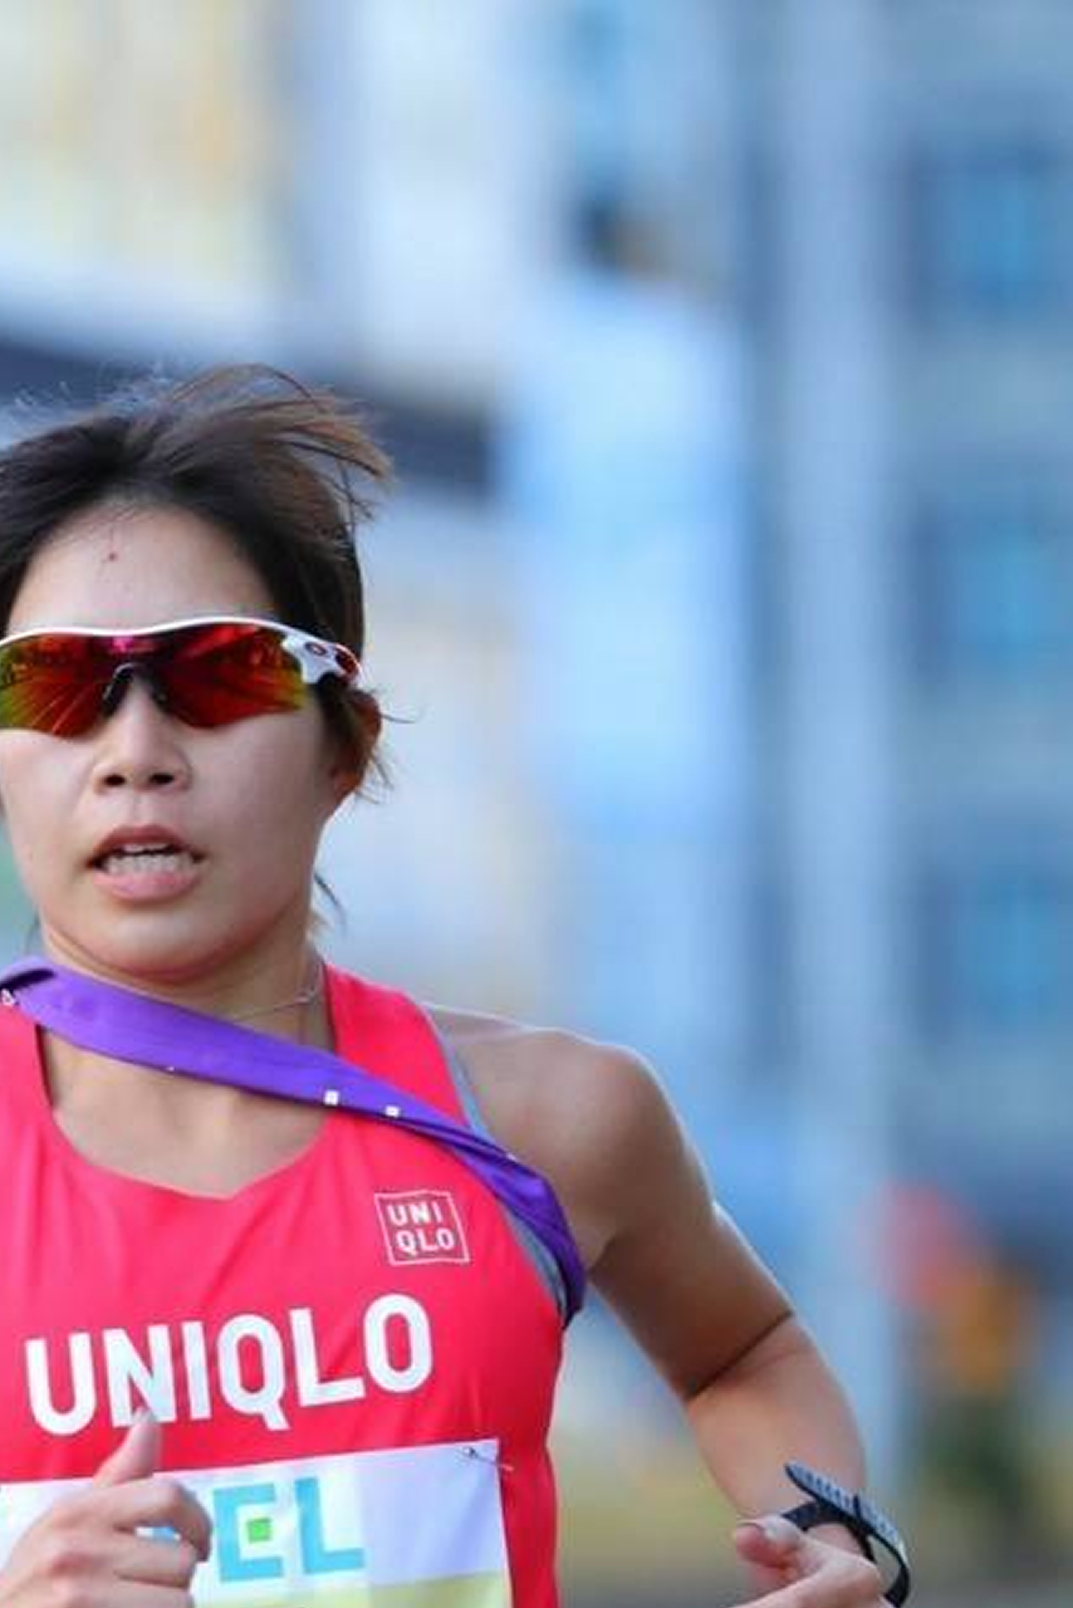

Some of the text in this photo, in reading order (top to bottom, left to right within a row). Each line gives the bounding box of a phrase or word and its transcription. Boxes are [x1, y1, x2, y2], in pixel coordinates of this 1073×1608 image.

[387, 1201, 443, 1226] UNI
[396, 1227, 455, 1256] QLO
[25, 1294, 433, 1436] UNIQLO
[151, 1476, 365, 1583] EL
